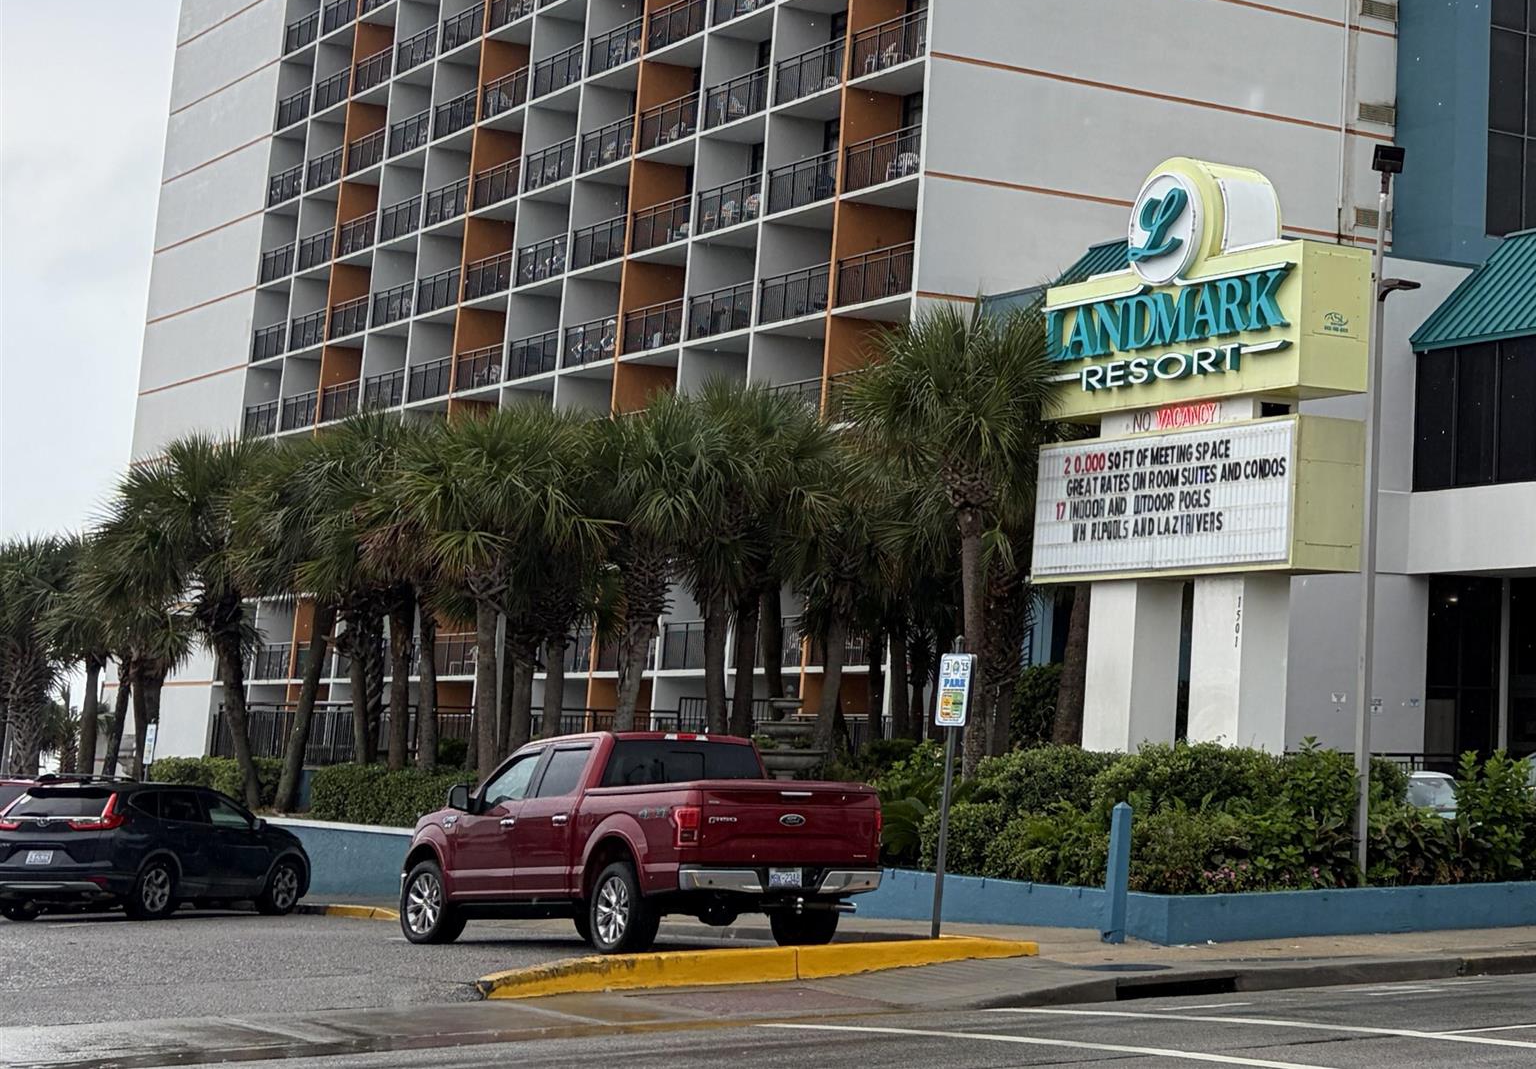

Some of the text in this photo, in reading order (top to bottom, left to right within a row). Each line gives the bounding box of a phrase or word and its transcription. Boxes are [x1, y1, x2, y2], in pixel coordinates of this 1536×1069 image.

[1046, 270, 1290, 361] LANDMARK
[1082, 343, 1243, 392] RESORT
[1133, 402, 1217, 433] NO VACANCY
[1122, 449, 1134, 468] FT
[1136, 447, 1149, 467] OF
[1150, 443, 1193, 466] MEETING
[1195, 439, 1231, 461] SPACE
[1066, 457, 1286, 497] GREAT RATES ON ROOM SUITES AND CONDOS
[1056, 501, 1066, 520] 17
[1069, 498, 1106, 520] INDOOR
[1107, 497, 1127, 516] AND
[1132, 517, 1155, 537] AND
[944, 678, 966, 688] PARK
